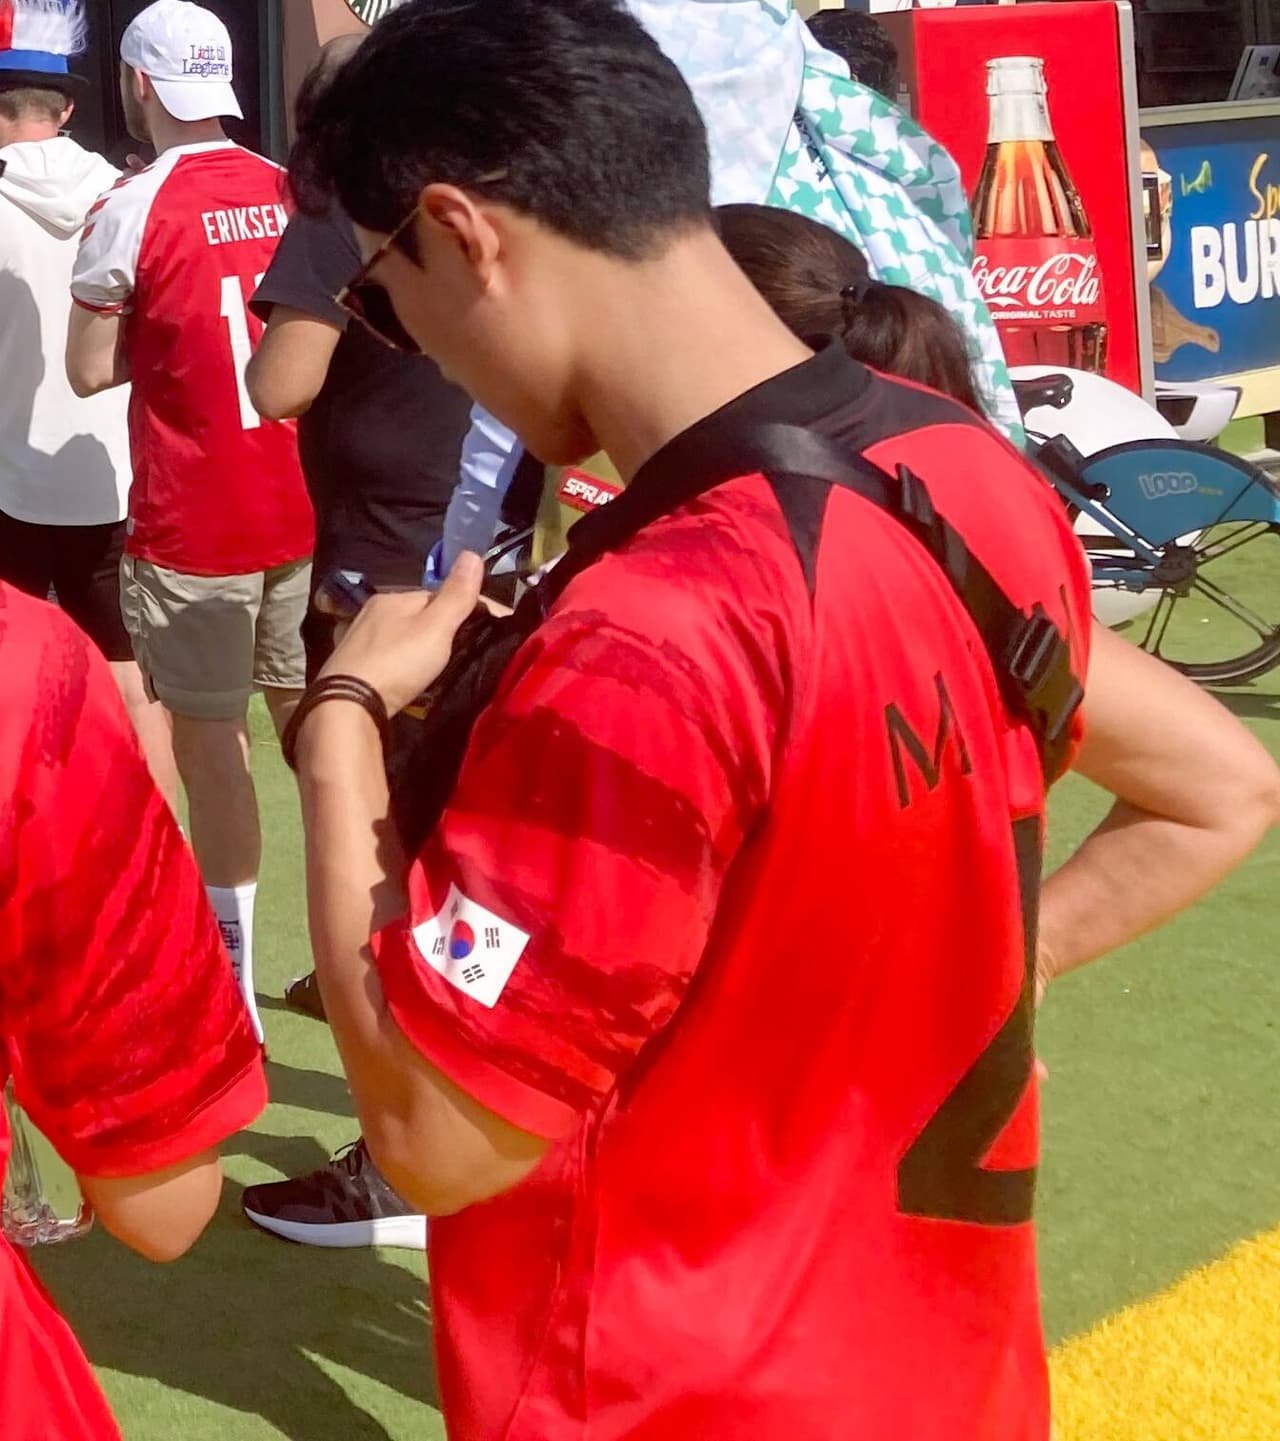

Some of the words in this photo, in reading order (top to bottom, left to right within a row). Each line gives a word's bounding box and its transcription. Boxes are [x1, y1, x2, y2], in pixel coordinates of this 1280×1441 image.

[201, 203, 289, 246] ERIKSEN
[991, 311, 1041, 320] ORIGINAL
[1044, 309, 1075, 318] TASTE
[884, 669, 973, 810] M
